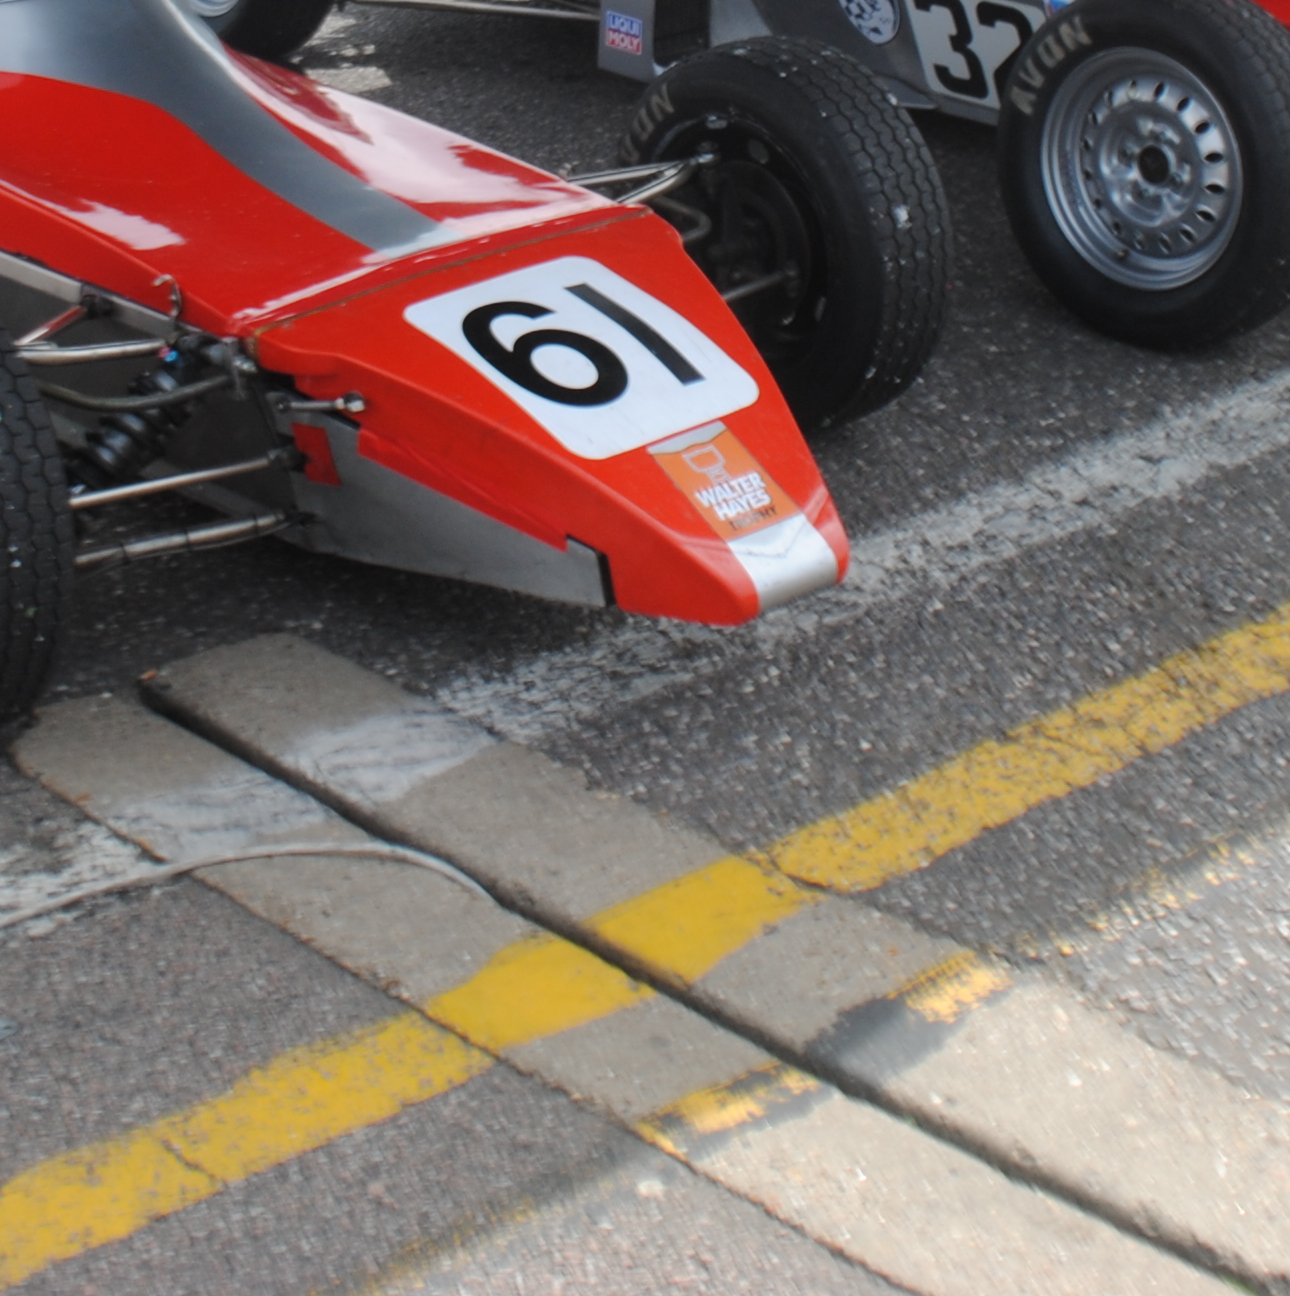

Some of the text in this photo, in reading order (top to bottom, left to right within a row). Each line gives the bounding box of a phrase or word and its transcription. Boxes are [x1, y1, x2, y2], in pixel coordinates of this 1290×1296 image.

[608, 13, 641, 37] LIQUI
[608, 30, 641, 53] MOLY
[1010, 15, 1092, 116] AVON
[619, 82, 675, 163] VON
[461, 282, 706, 408] 61
[694, 471, 767, 508] WALTER
[712, 488, 772, 521] HAYES
